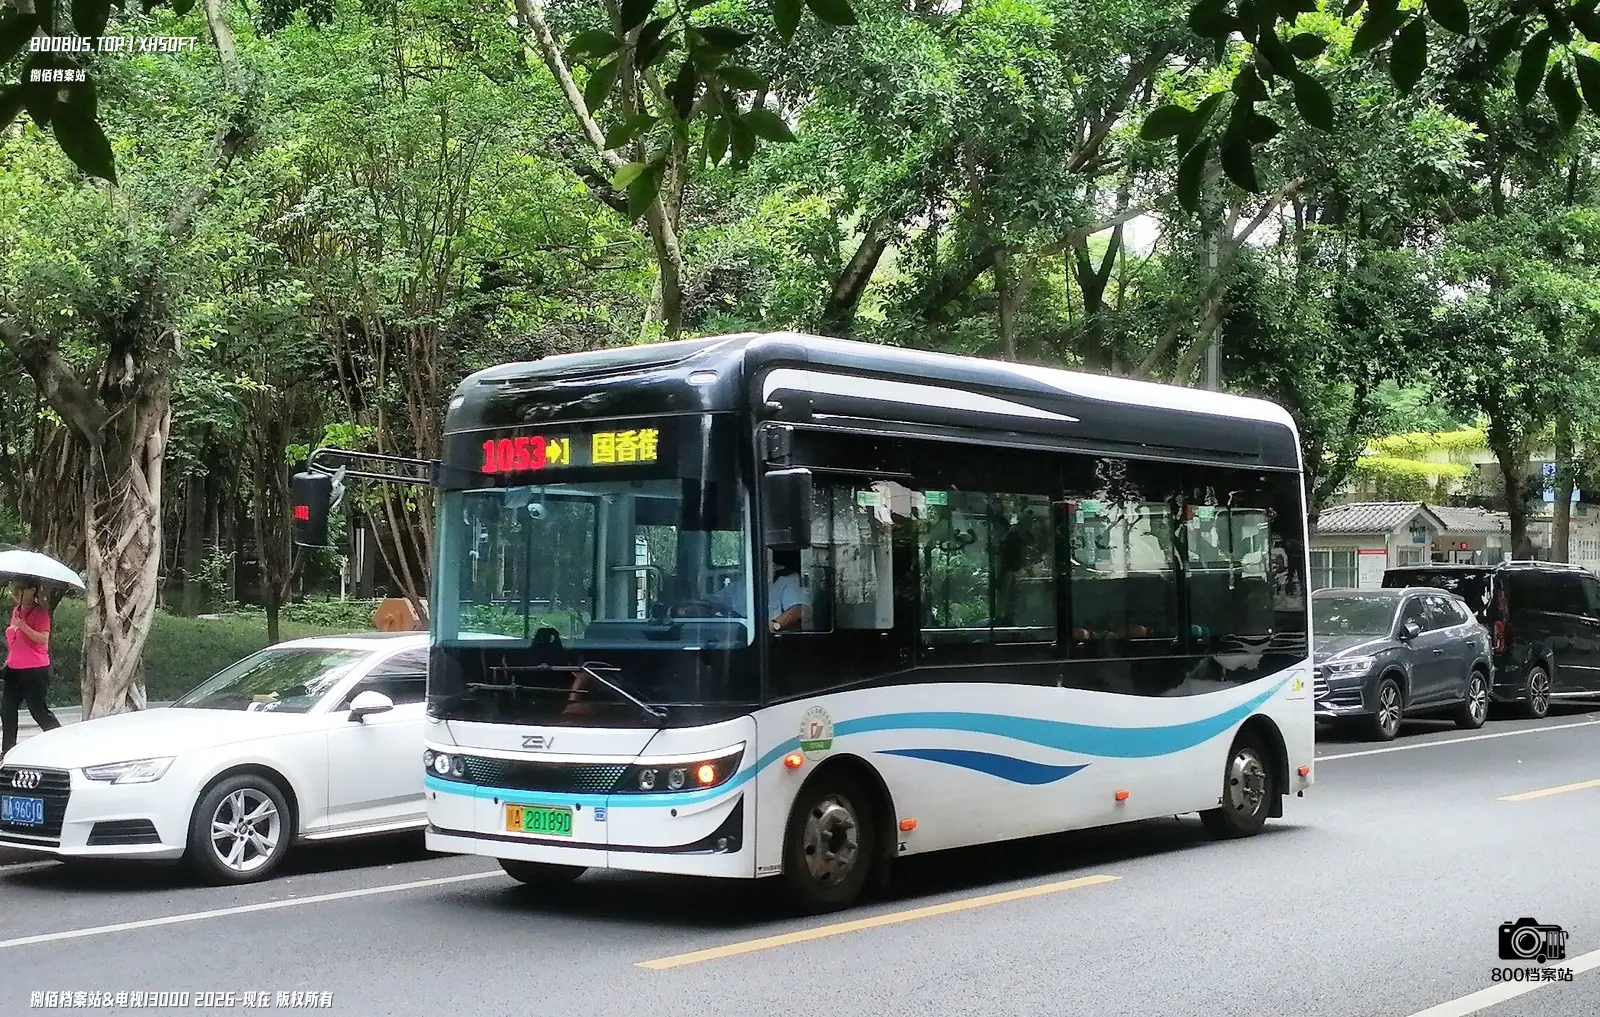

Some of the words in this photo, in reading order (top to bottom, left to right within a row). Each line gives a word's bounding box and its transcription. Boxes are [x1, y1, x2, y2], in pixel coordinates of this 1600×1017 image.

[481, 435, 547, 474] 1053
[592, 428, 659, 464] 国香街
[521, 735, 554, 750] ZEV
[526, 809, 572, 833] 28189D
